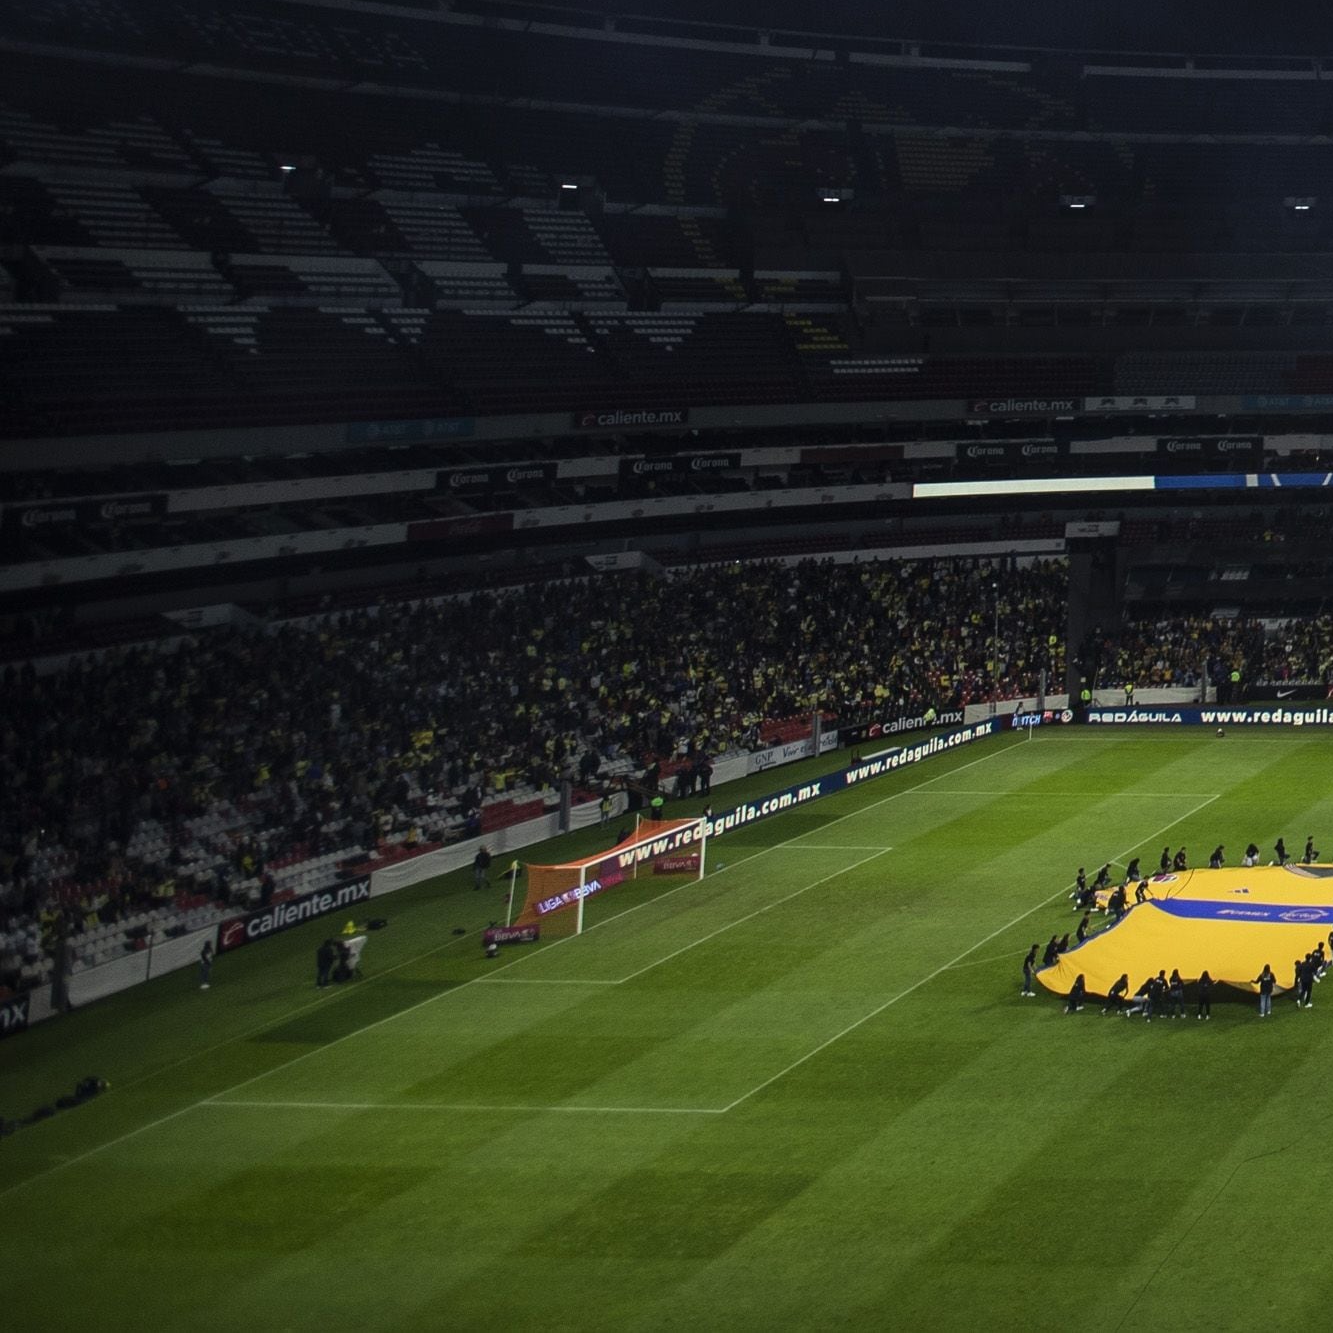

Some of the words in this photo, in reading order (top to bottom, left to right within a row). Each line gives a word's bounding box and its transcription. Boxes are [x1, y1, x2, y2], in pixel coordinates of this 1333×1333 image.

[991, 399, 1072, 413] caliente.mx
[598, 409, 683, 426] caliente.mx
[968, 446, 1004, 457] Corona
[1022, 444, 1058, 456] Corona
[1166, 441, 1202, 452] Corona
[1217, 440, 1251, 452] Corona
[634, 460, 672, 474] Corona
[692, 456, 731, 470] Corona
[452, 472, 489, 487] Corona
[508, 467, 544, 483] Corona
[756, 750, 774, 765] GNP
[846, 722, 992, 784] www.redaguila.com.mx
[619, 782, 821, 868] www.redaguila.com.mx
[247, 879, 371, 939] caliente.mx
[539, 893, 565, 914] LIGA
